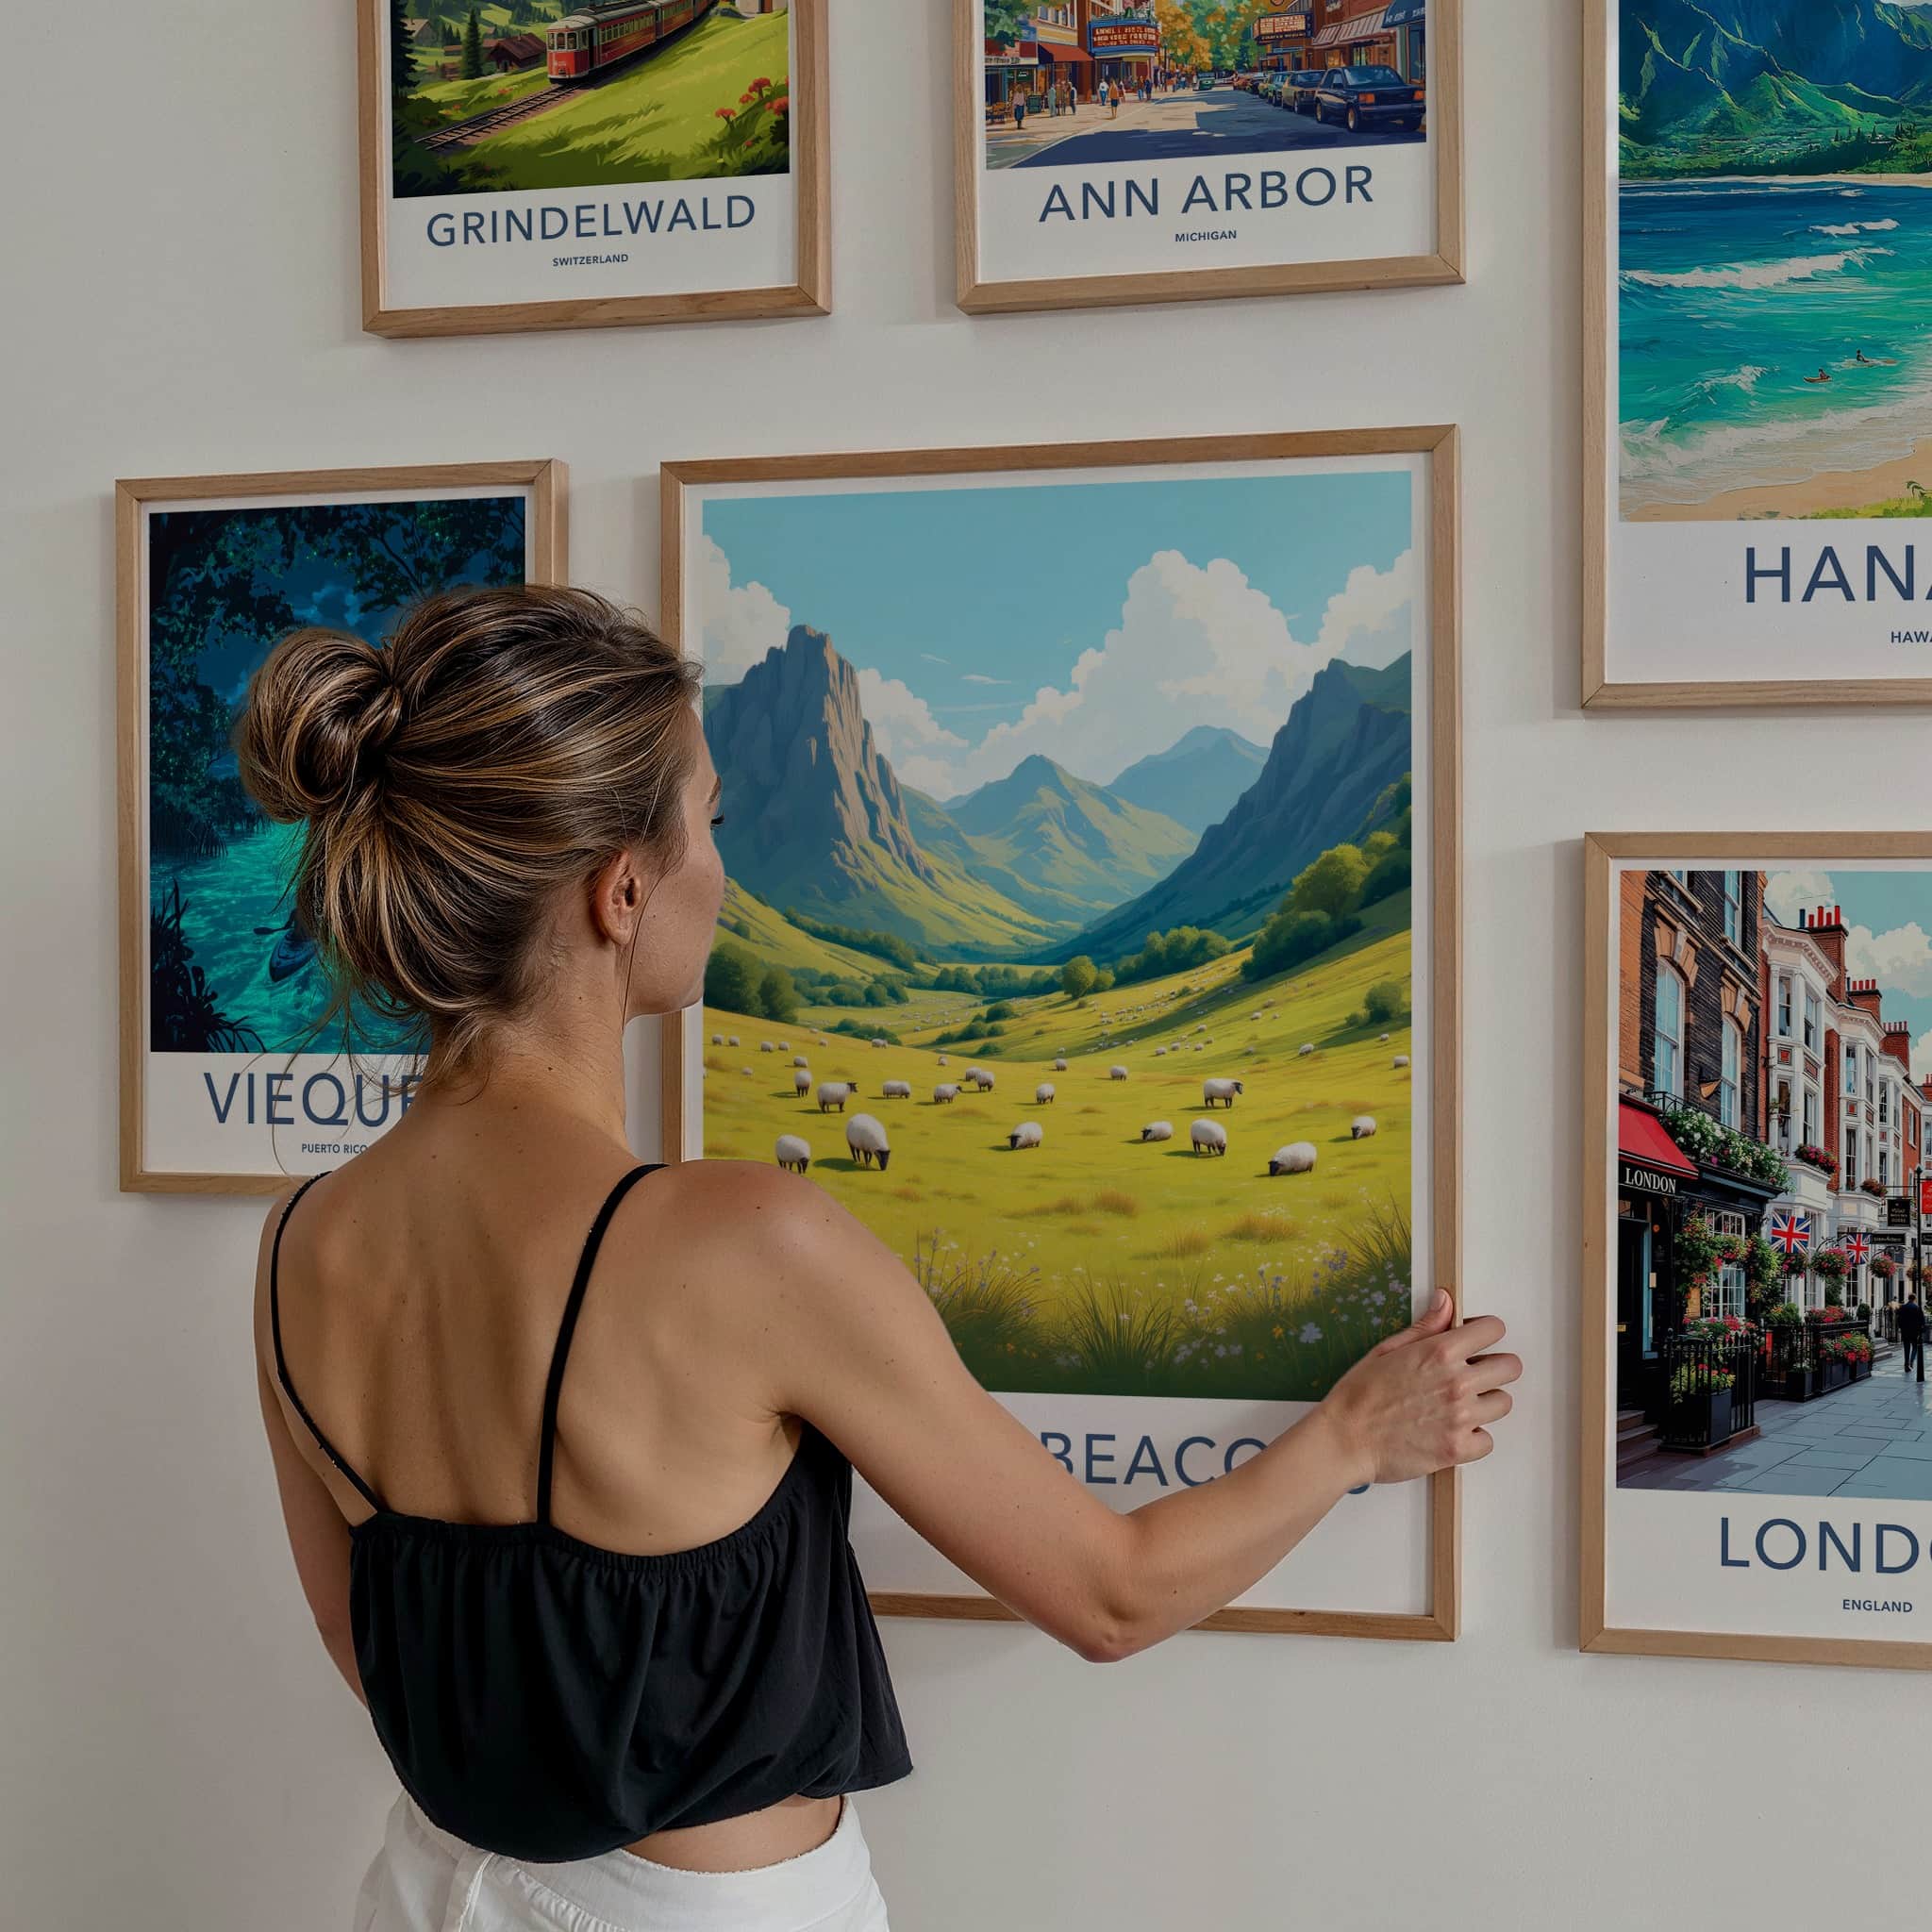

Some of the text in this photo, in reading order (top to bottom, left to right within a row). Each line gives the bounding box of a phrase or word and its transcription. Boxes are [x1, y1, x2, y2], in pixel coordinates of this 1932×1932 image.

[1039, 164, 1374, 223] ANN ARBOR
[426, 194, 756, 247] GRINDELWALD
[1174, 229, 1237, 242] MICHIGAN
[552, 253, 629, 267] SWITZERLAND
[1745, 544, 1932, 603] HAN
[1890, 630, 1932, 643] HAW
[203, 1072, 424, 1127] VIEQUE
[301, 1143, 341, 1154] PUERTO
[1624, 1167, 1676, 1194] LONDON
[1721, 1517, 1932, 1574] LONDO
[1842, 1599, 1913, 1613] ENGLAND
